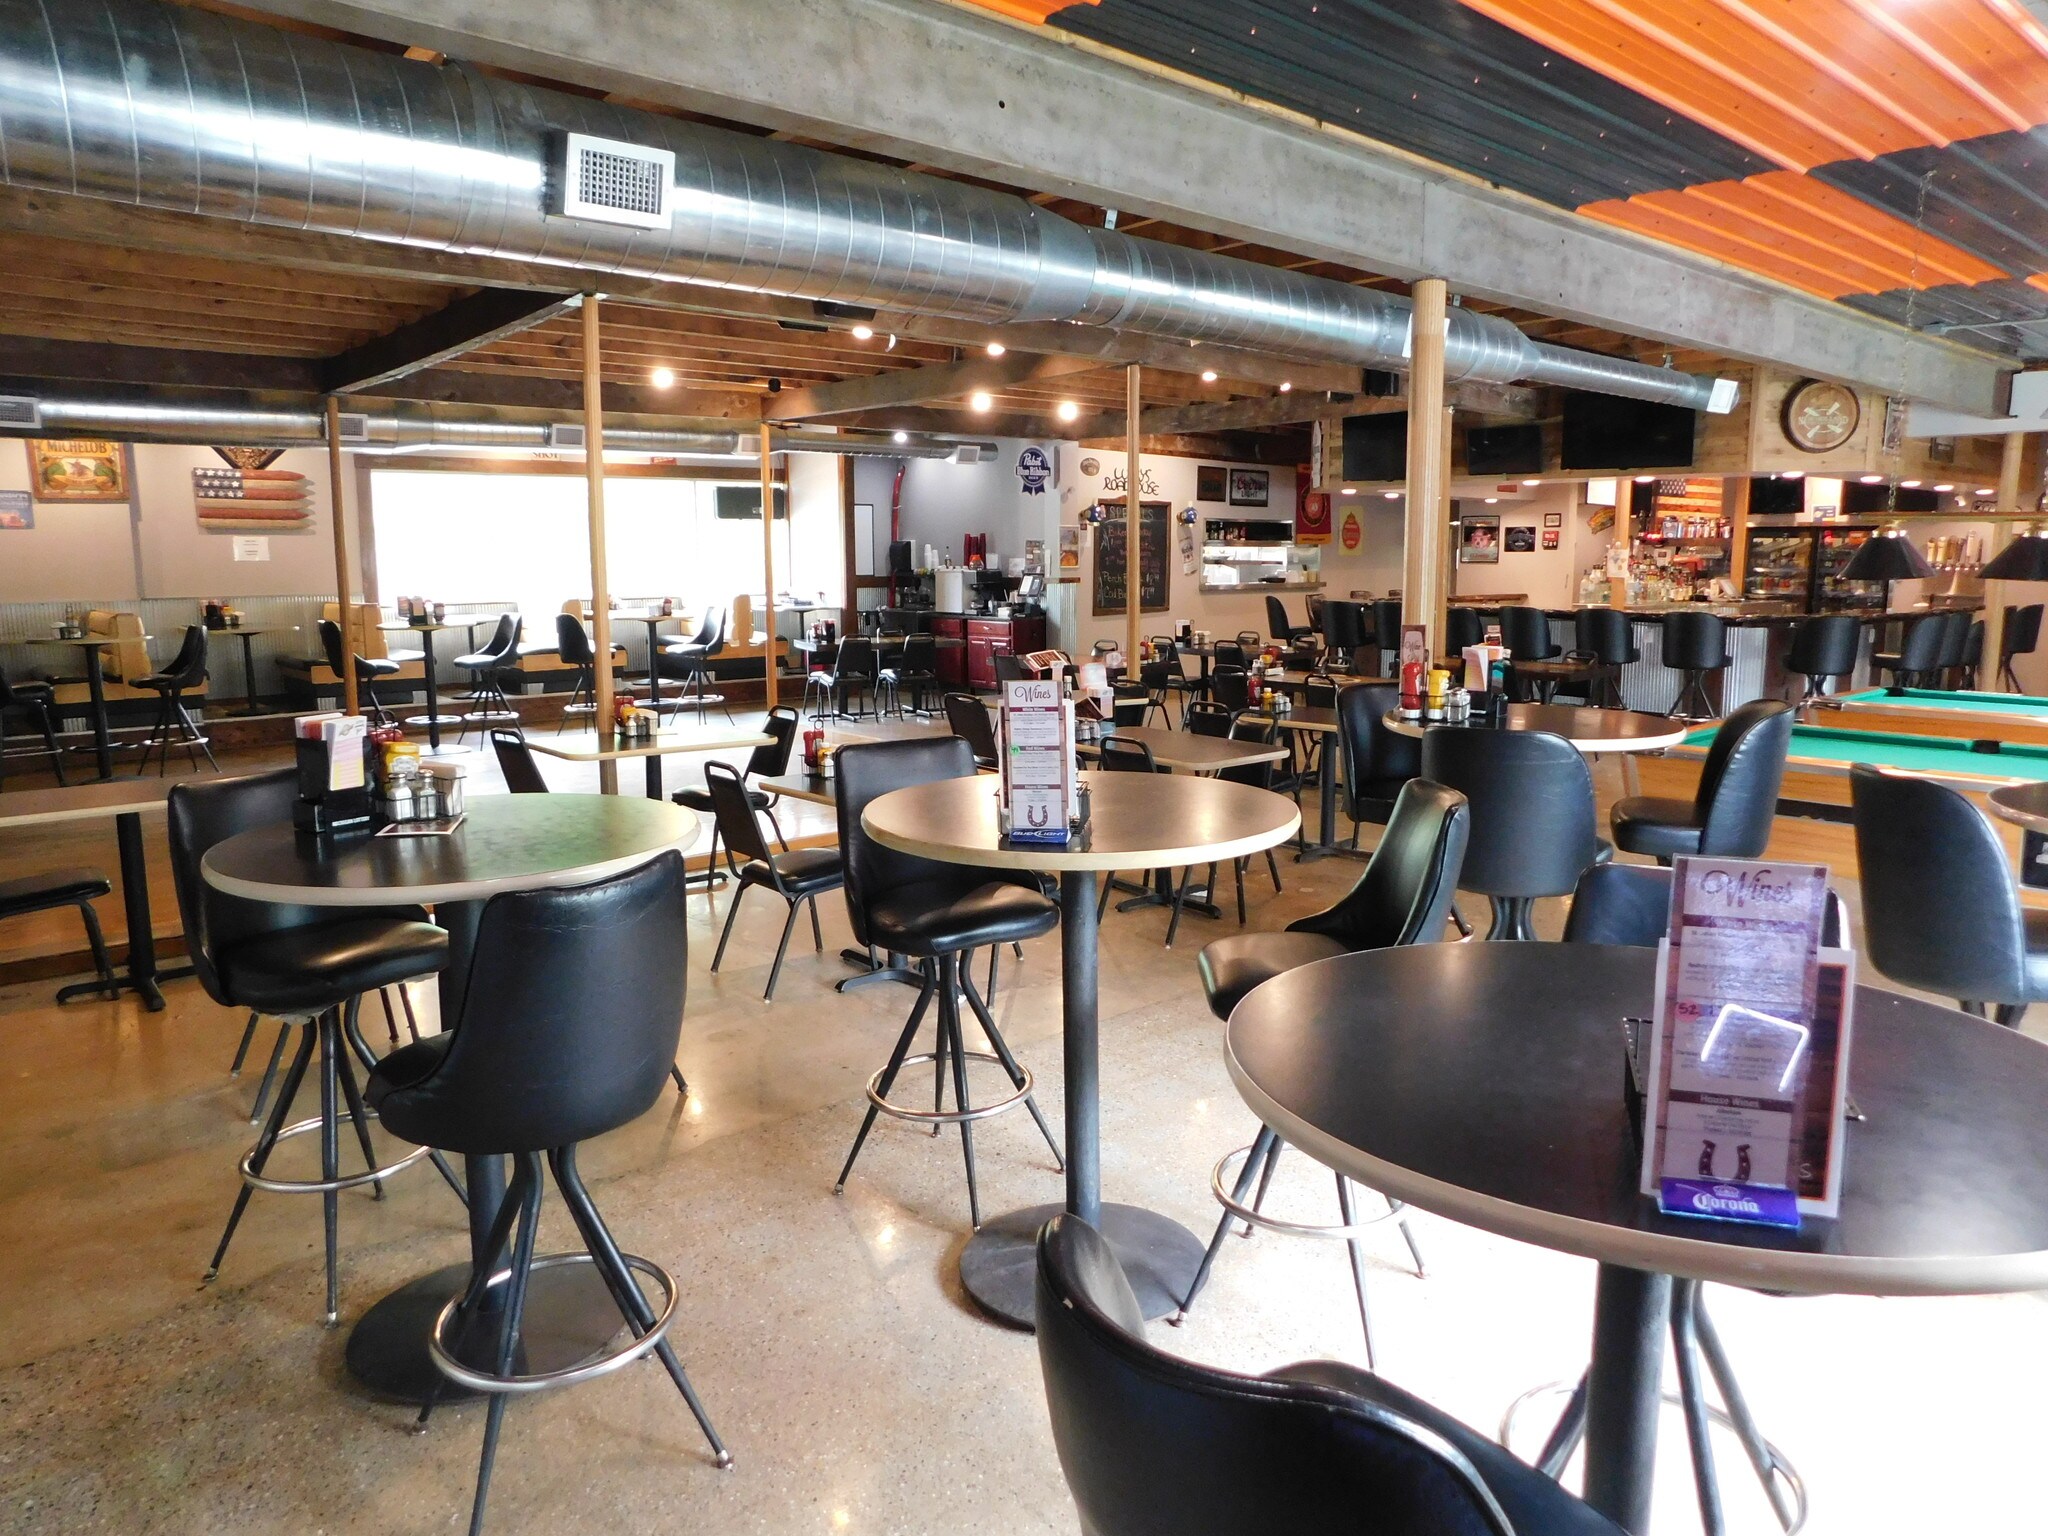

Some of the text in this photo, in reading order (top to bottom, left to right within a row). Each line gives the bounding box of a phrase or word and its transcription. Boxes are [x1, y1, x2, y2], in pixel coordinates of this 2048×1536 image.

[47, 440, 107, 454] MICHELOB
[1023, 453, 1042, 466] Pabst
[1014, 684, 1051, 702] Wines
[1701, 869, 1793, 908] Wines
[1692, 1191, 1761, 1213] Corona
